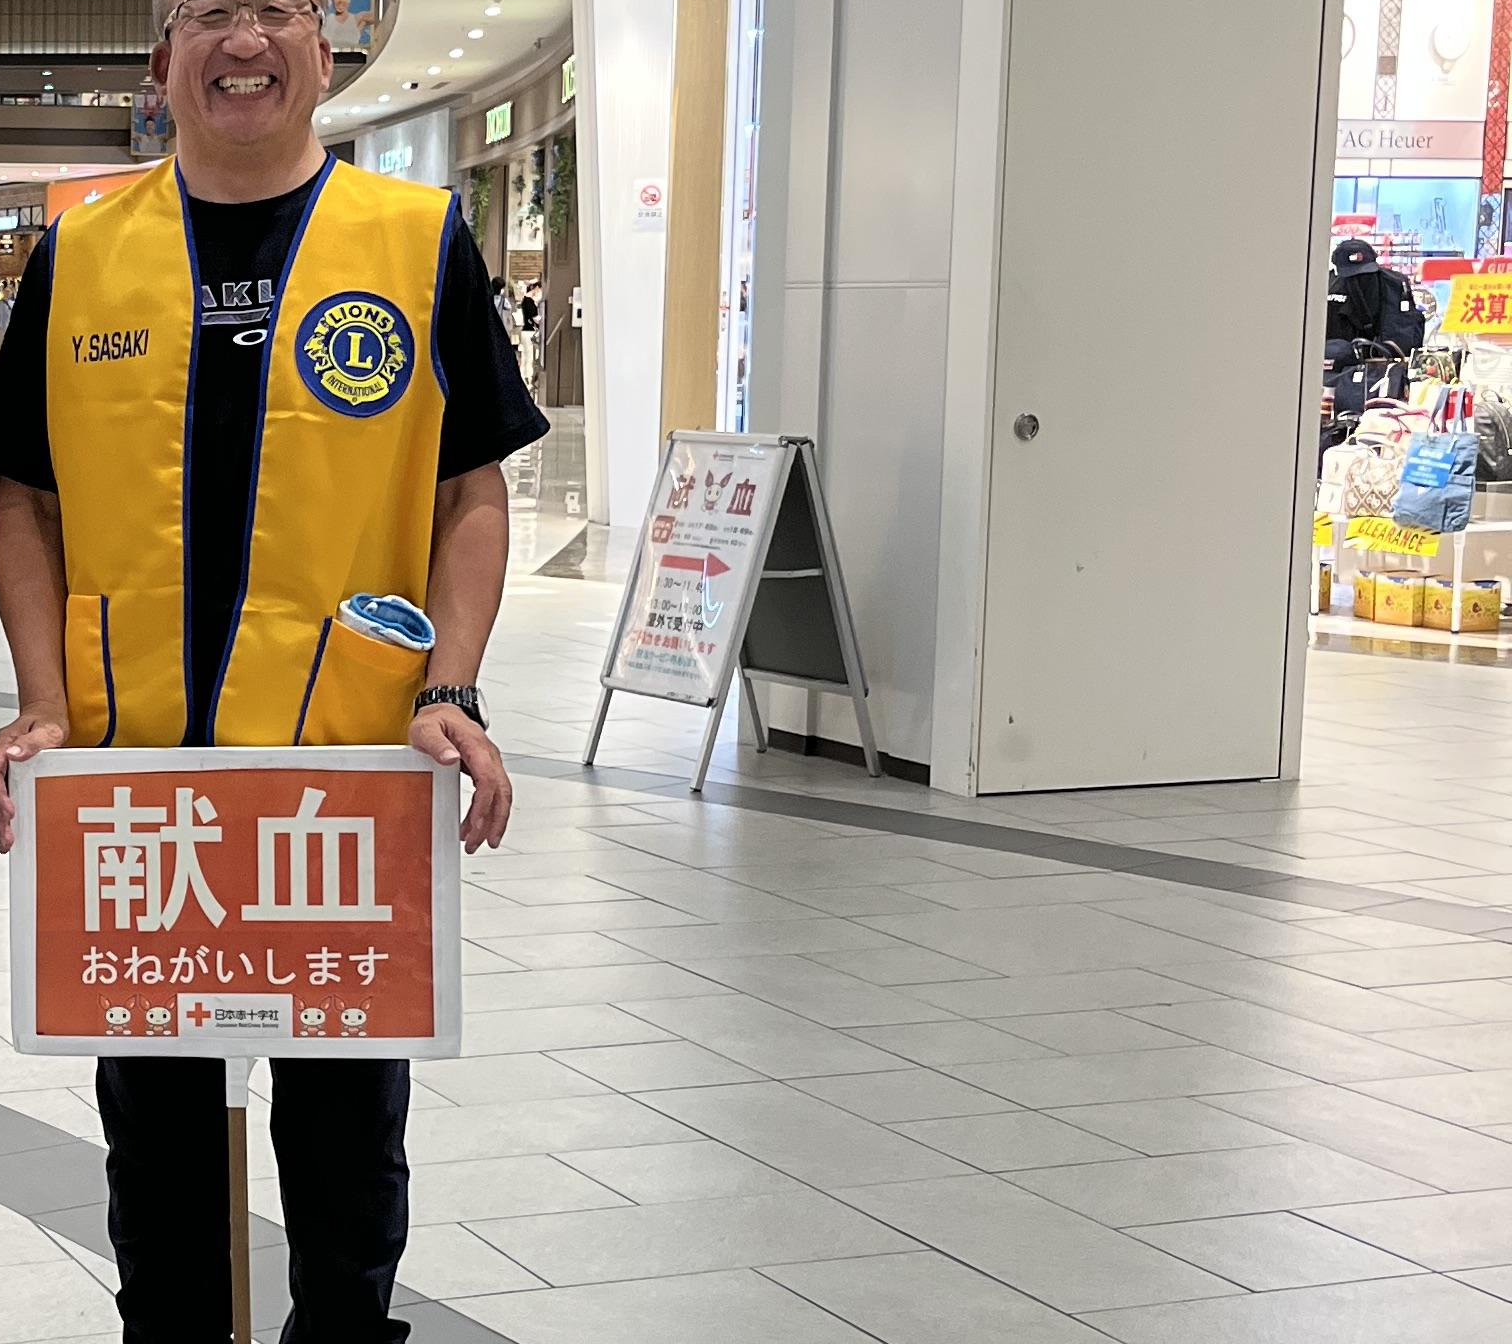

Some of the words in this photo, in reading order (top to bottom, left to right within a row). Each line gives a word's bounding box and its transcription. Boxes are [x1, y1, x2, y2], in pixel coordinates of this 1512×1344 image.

[1338, 129, 1372, 149] AG
[1379, 129, 1434, 149] Heuer
[329, 305, 390, 329] LIONS
[72, 328, 149, 363] Y.SASAKI
[346, 332, 372, 369] L
[326, 375, 384, 397] INTERNATIONAL
[1357, 518, 1427, 553] CLEARANCE
[77, 786, 392, 932] 献血
[82, 945, 389, 985] おねがいします
[215, 1008, 279, 1020] 日本赤十字社
